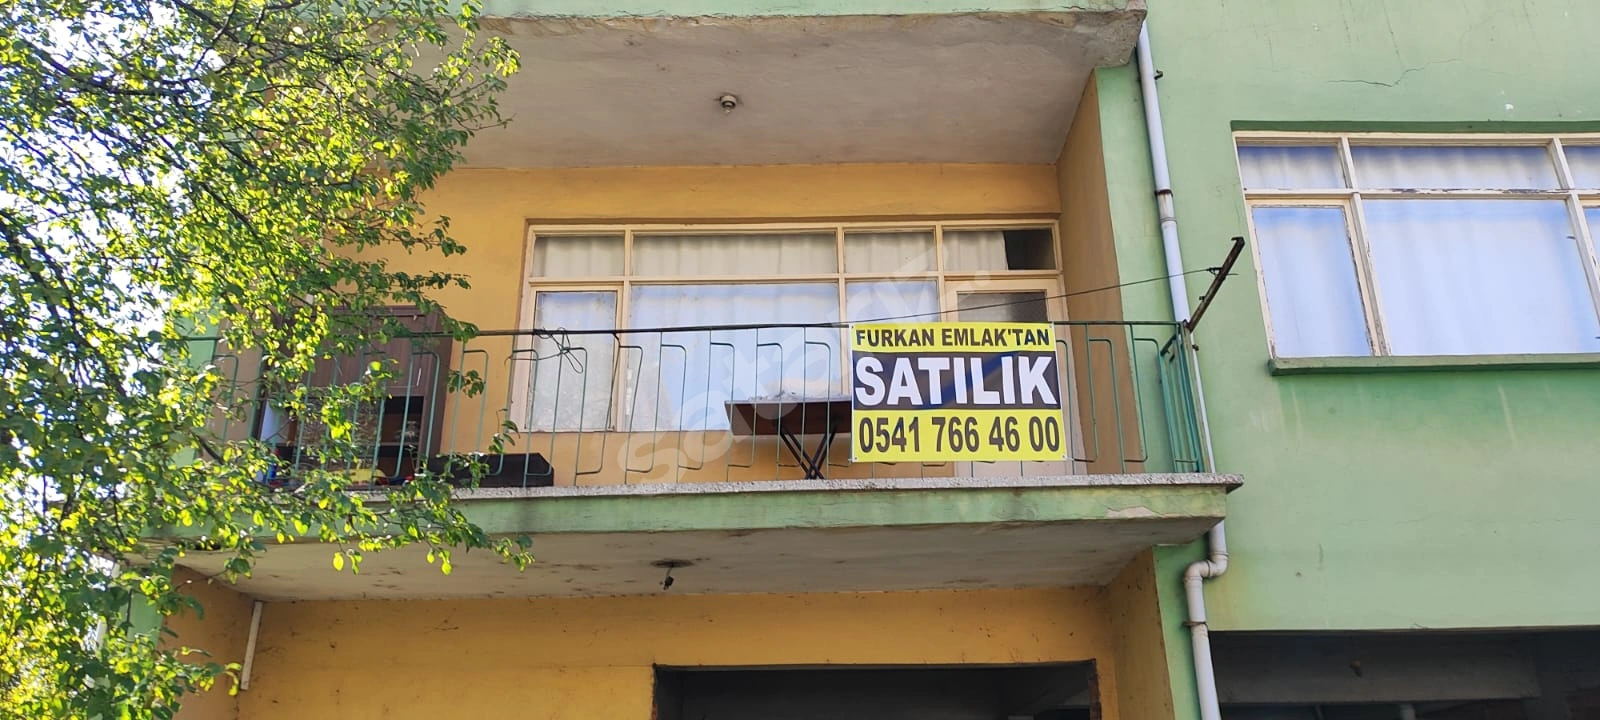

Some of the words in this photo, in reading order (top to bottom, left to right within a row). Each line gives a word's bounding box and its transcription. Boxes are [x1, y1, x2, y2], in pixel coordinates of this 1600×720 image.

[856, 329, 935, 347] FURKAN
[942, 328, 1050, 346] EMLAK'TAN
[855, 356, 1057, 406] SATILIK
[859, 416, 920, 453] 0541
[931, 416, 980, 452] 766
[988, 416, 1020, 452] 46
[1029, 416, 1060, 452] 00
